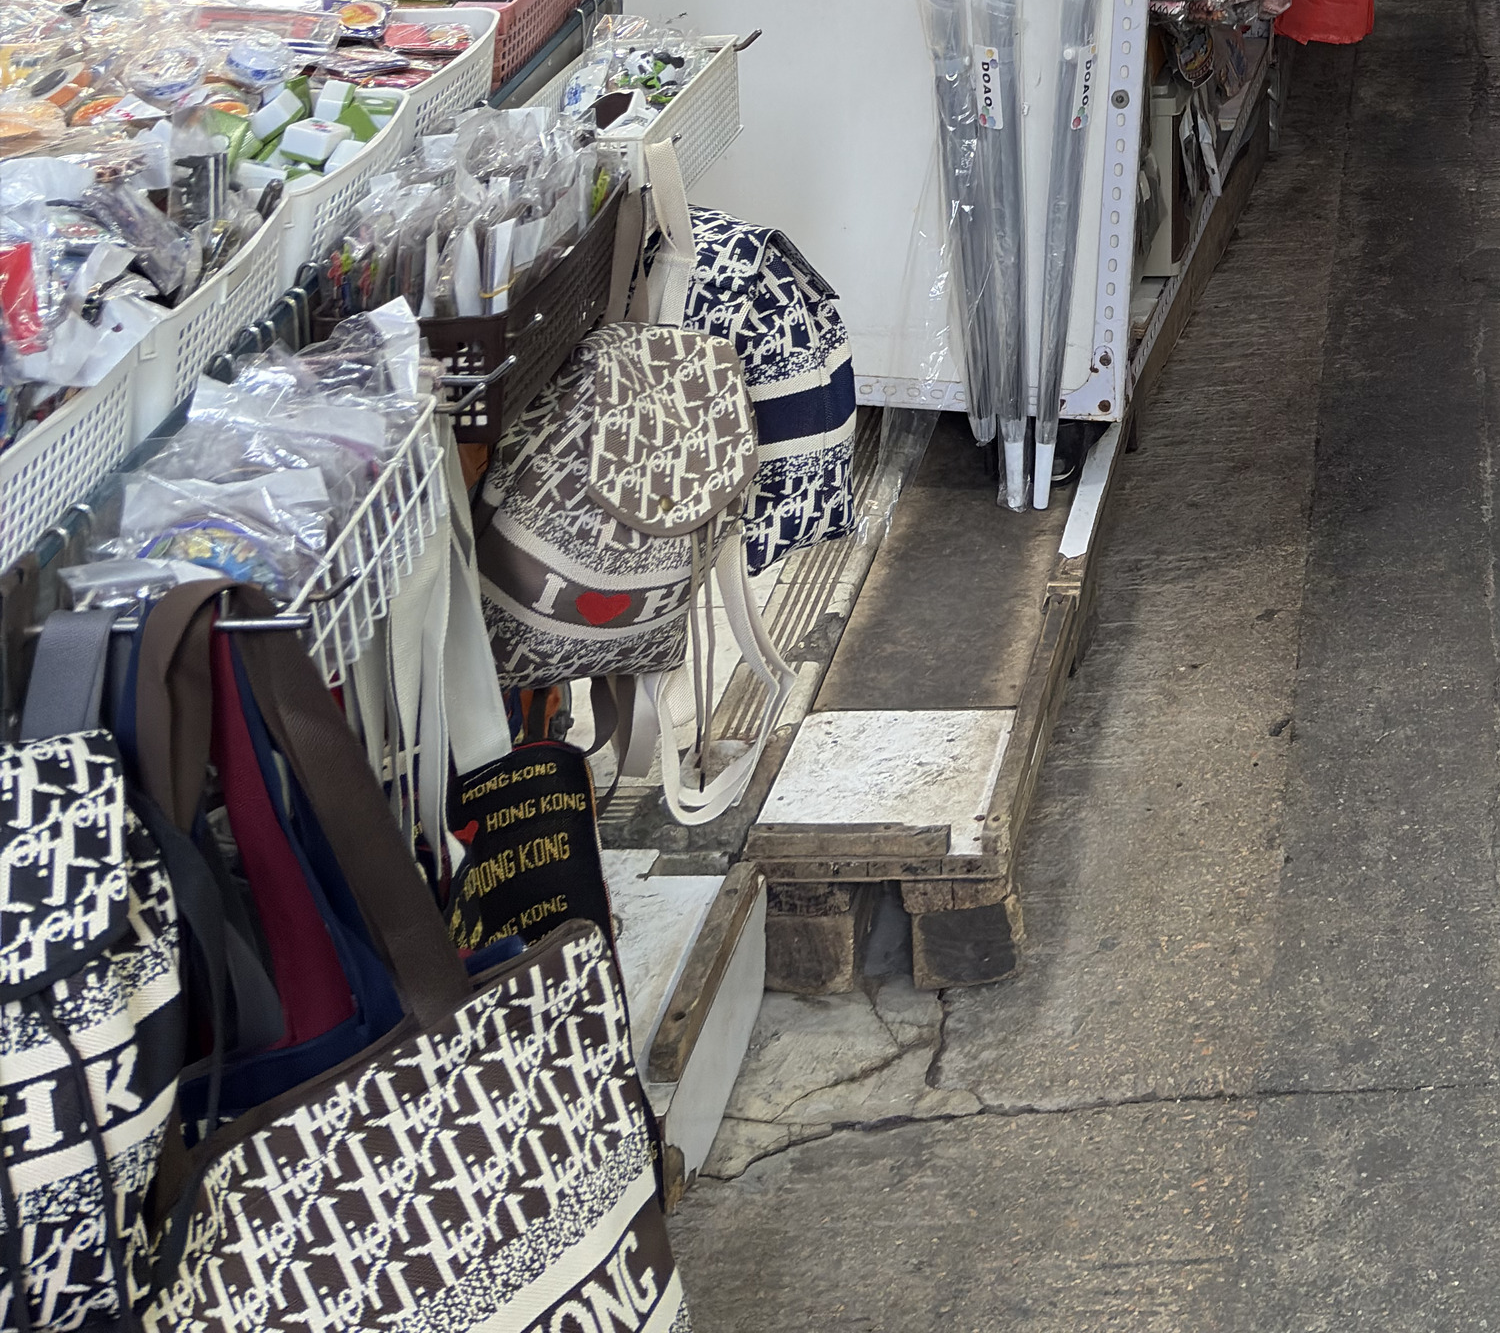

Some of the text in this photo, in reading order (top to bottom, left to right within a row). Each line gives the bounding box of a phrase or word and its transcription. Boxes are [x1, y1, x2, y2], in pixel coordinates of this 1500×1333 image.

[981, 61, 993, 108] DOAO
[1081, 59, 1093, 107] DOAO
[531, 572, 569, 613] I
[461, 762, 558, 805] HONG KONG
[486, 793, 586, 833] HONG KONG
[518, 831, 571, 874] KONG
[520, 894, 569, 930] KONG
